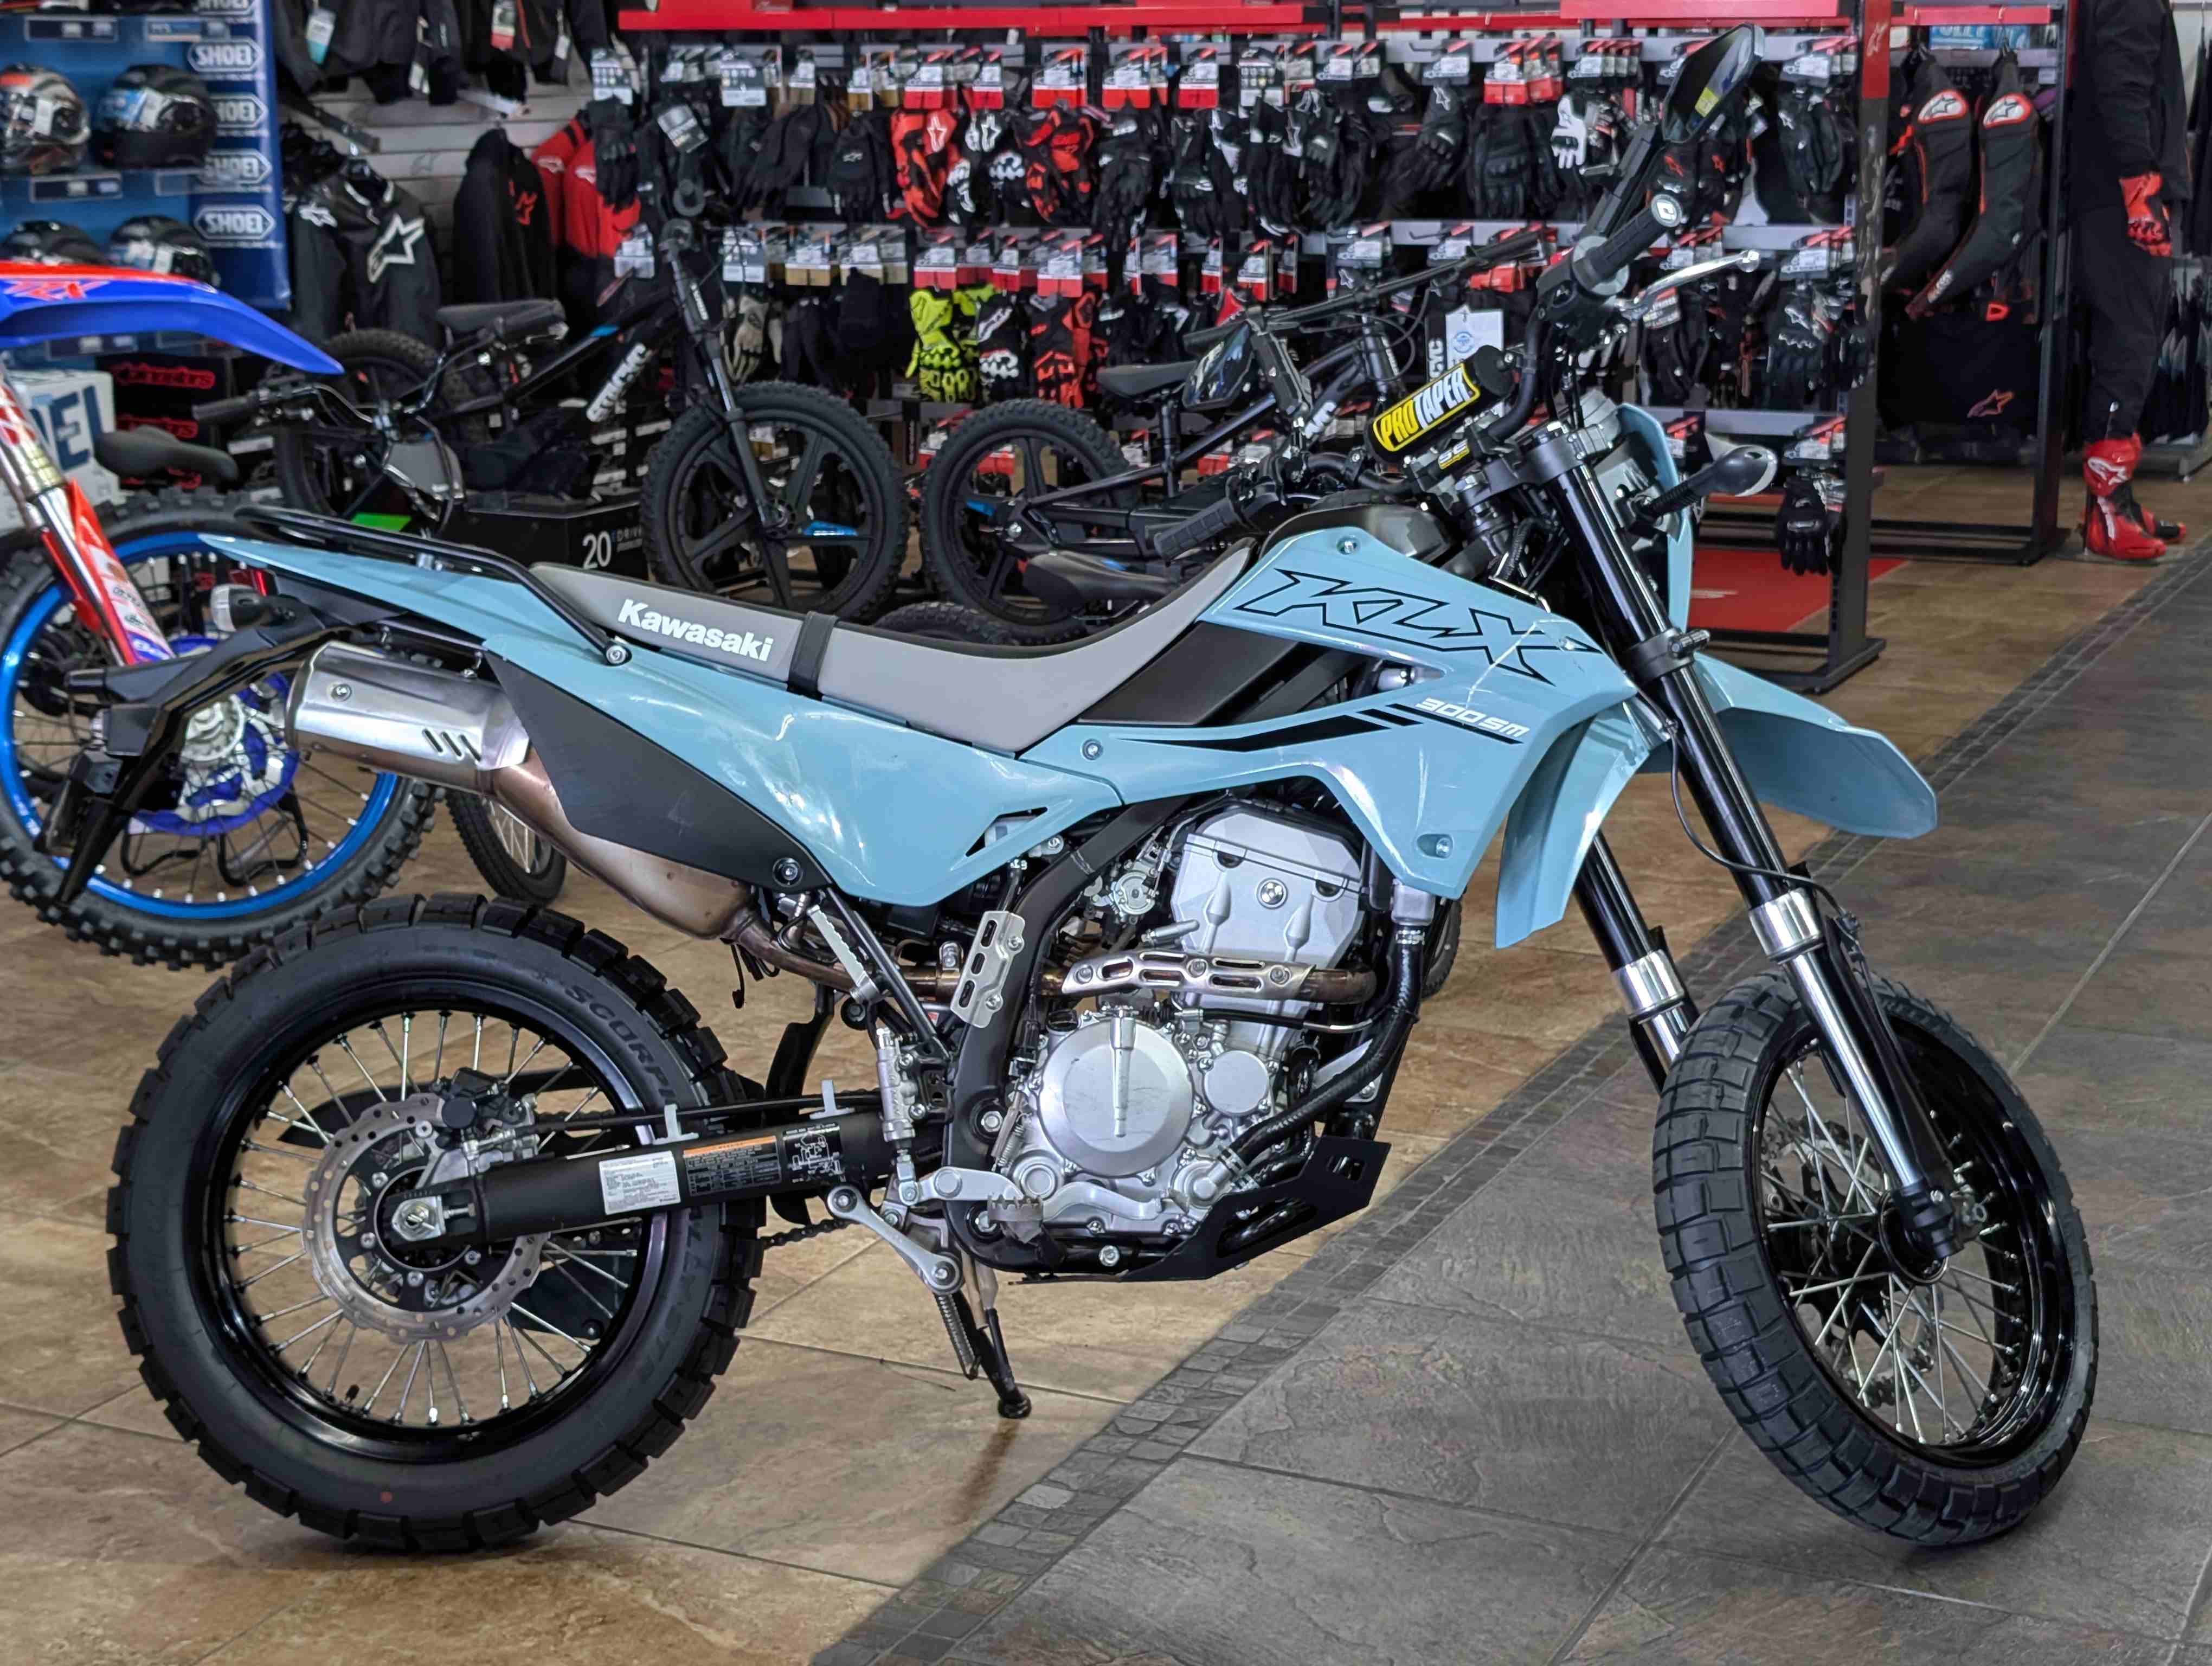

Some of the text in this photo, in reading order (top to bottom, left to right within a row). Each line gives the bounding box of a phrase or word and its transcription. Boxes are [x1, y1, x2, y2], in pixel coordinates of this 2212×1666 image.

[196, 45, 252, 65] SHOEI
[205, 213, 262, 233] SHOEI
[582, 530, 612, 569] 20
[618, 599, 774, 662] Kawasaki
[1233, 568, 1603, 686] KLX
[1414, 697, 1531, 738] 300SM
[564, 983, 677, 1104] SCORPI
